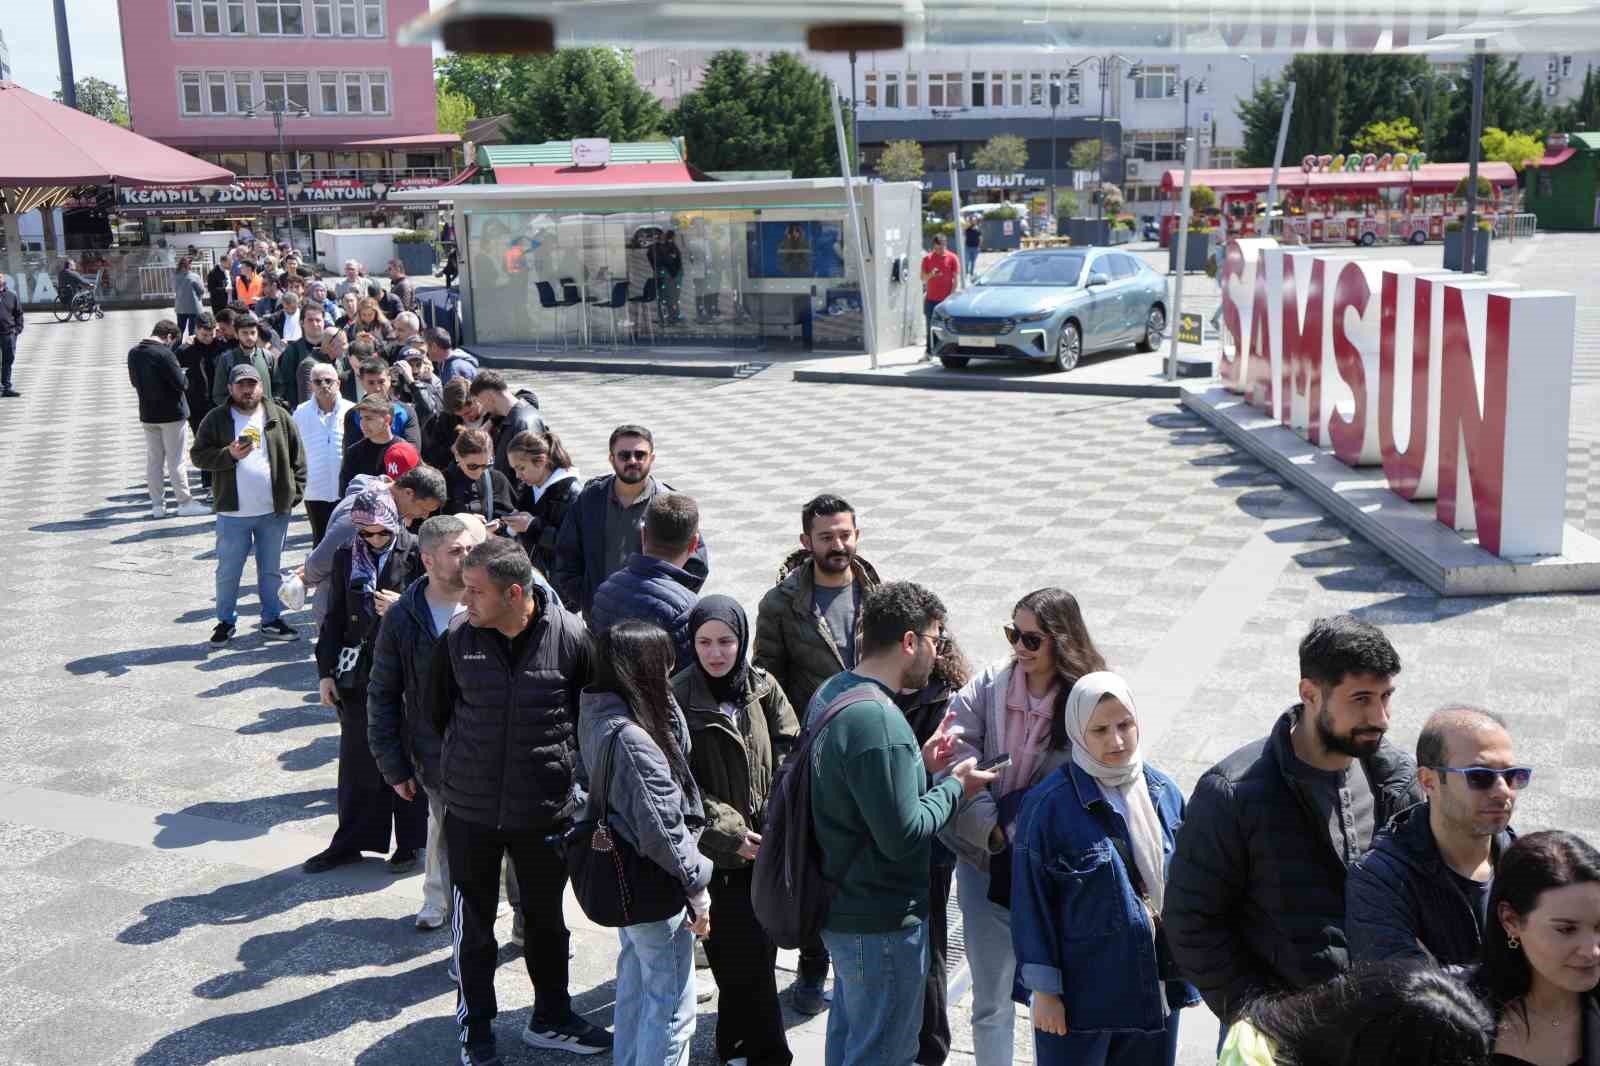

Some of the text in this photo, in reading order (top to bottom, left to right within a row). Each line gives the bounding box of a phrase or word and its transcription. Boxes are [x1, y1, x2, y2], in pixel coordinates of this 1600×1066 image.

[1302, 153, 1426, 174] STARPARK
[976, 173, 1024, 187] BULUT
[1219, 238, 1513, 557] SAMSUN
